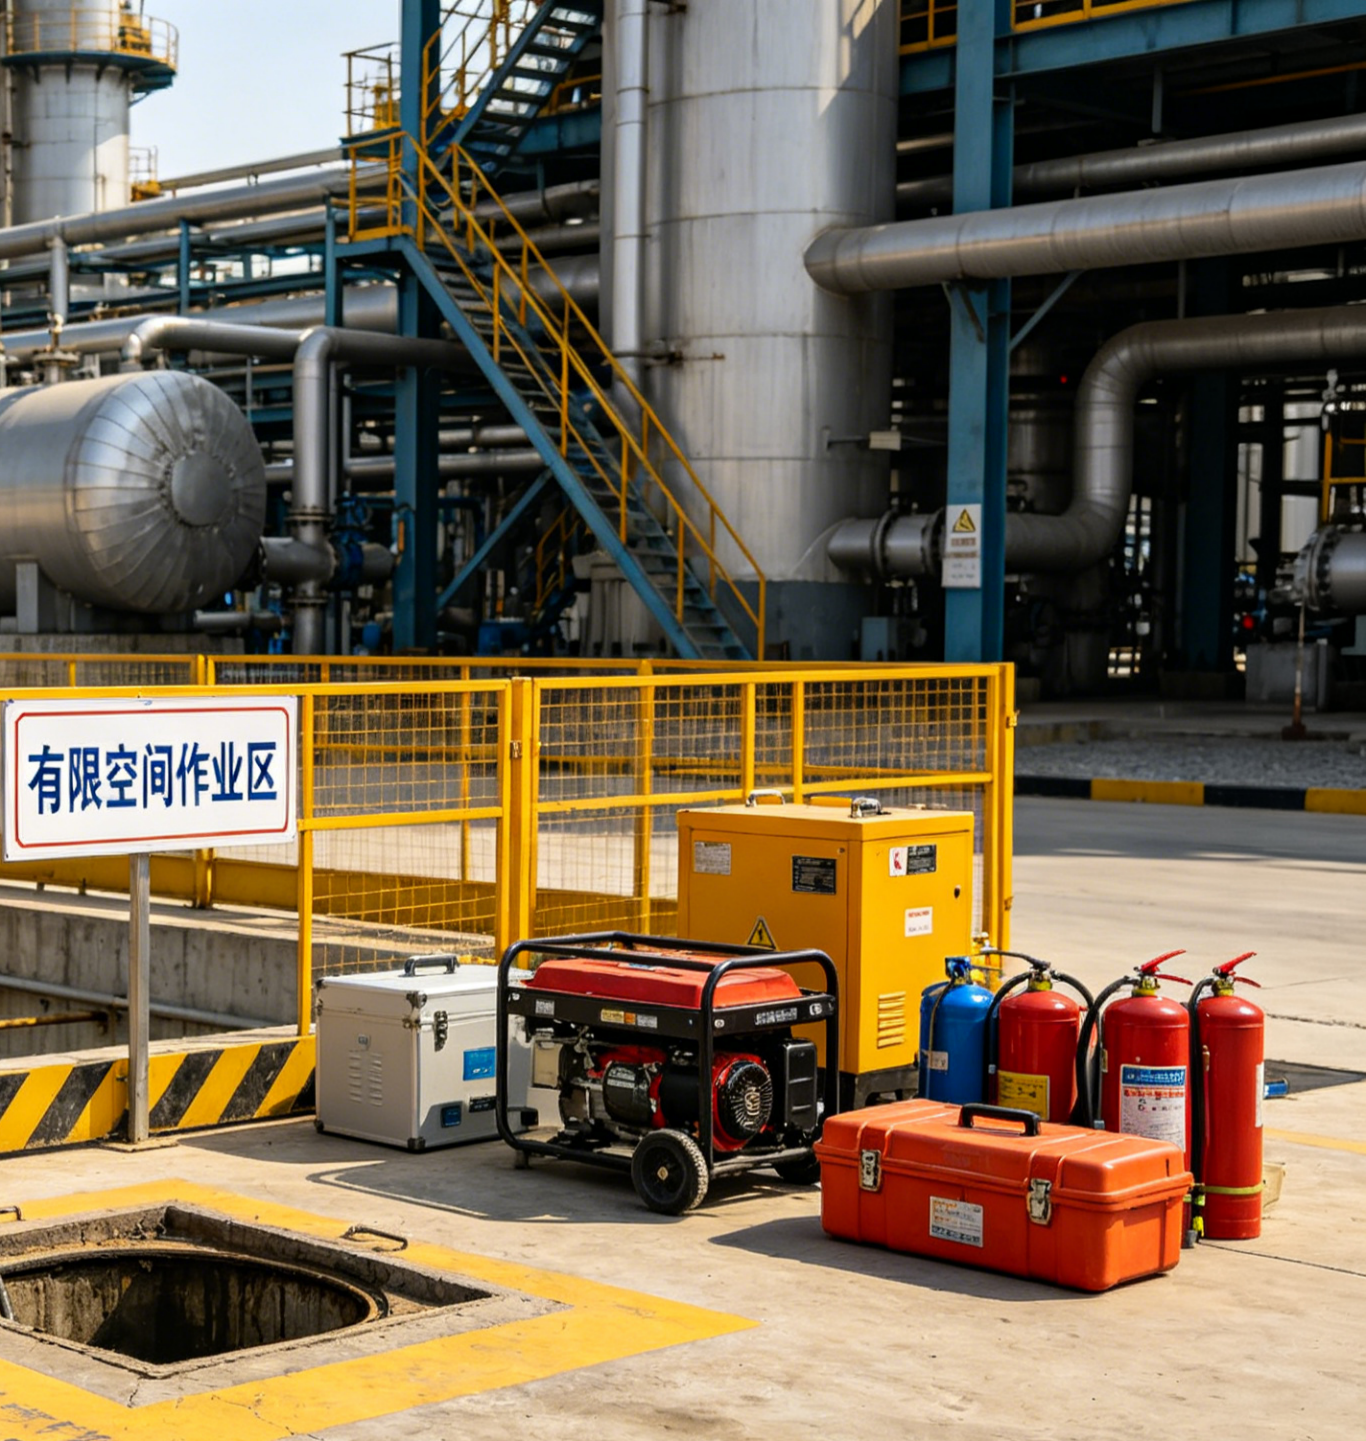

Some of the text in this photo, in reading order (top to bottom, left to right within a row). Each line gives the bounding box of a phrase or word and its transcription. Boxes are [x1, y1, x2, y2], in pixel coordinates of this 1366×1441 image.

[28, 741, 277, 814] 有限空间作业区
